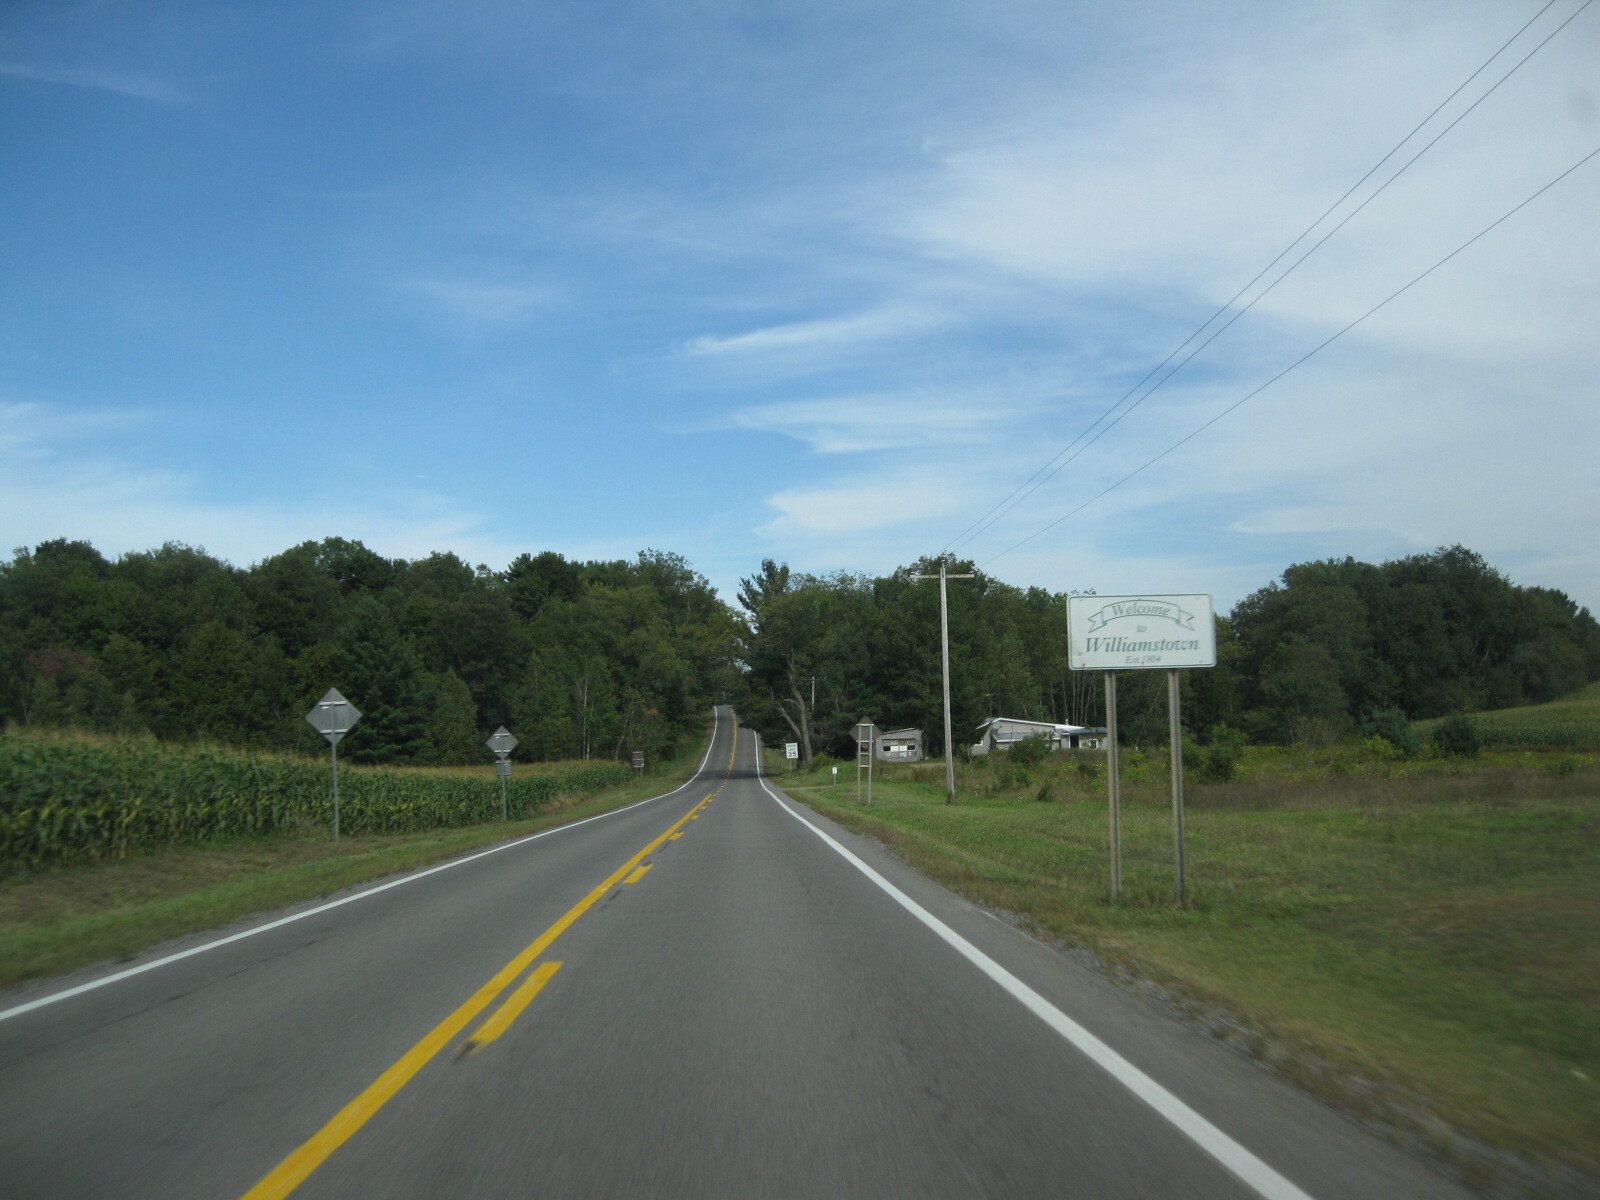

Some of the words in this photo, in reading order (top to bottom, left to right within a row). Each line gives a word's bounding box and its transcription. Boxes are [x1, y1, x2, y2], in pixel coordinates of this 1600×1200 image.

[1112, 602, 1170, 616] Welcome
[1136, 625, 1147, 633] to
[1085, 637, 1199, 652] Williamstown
